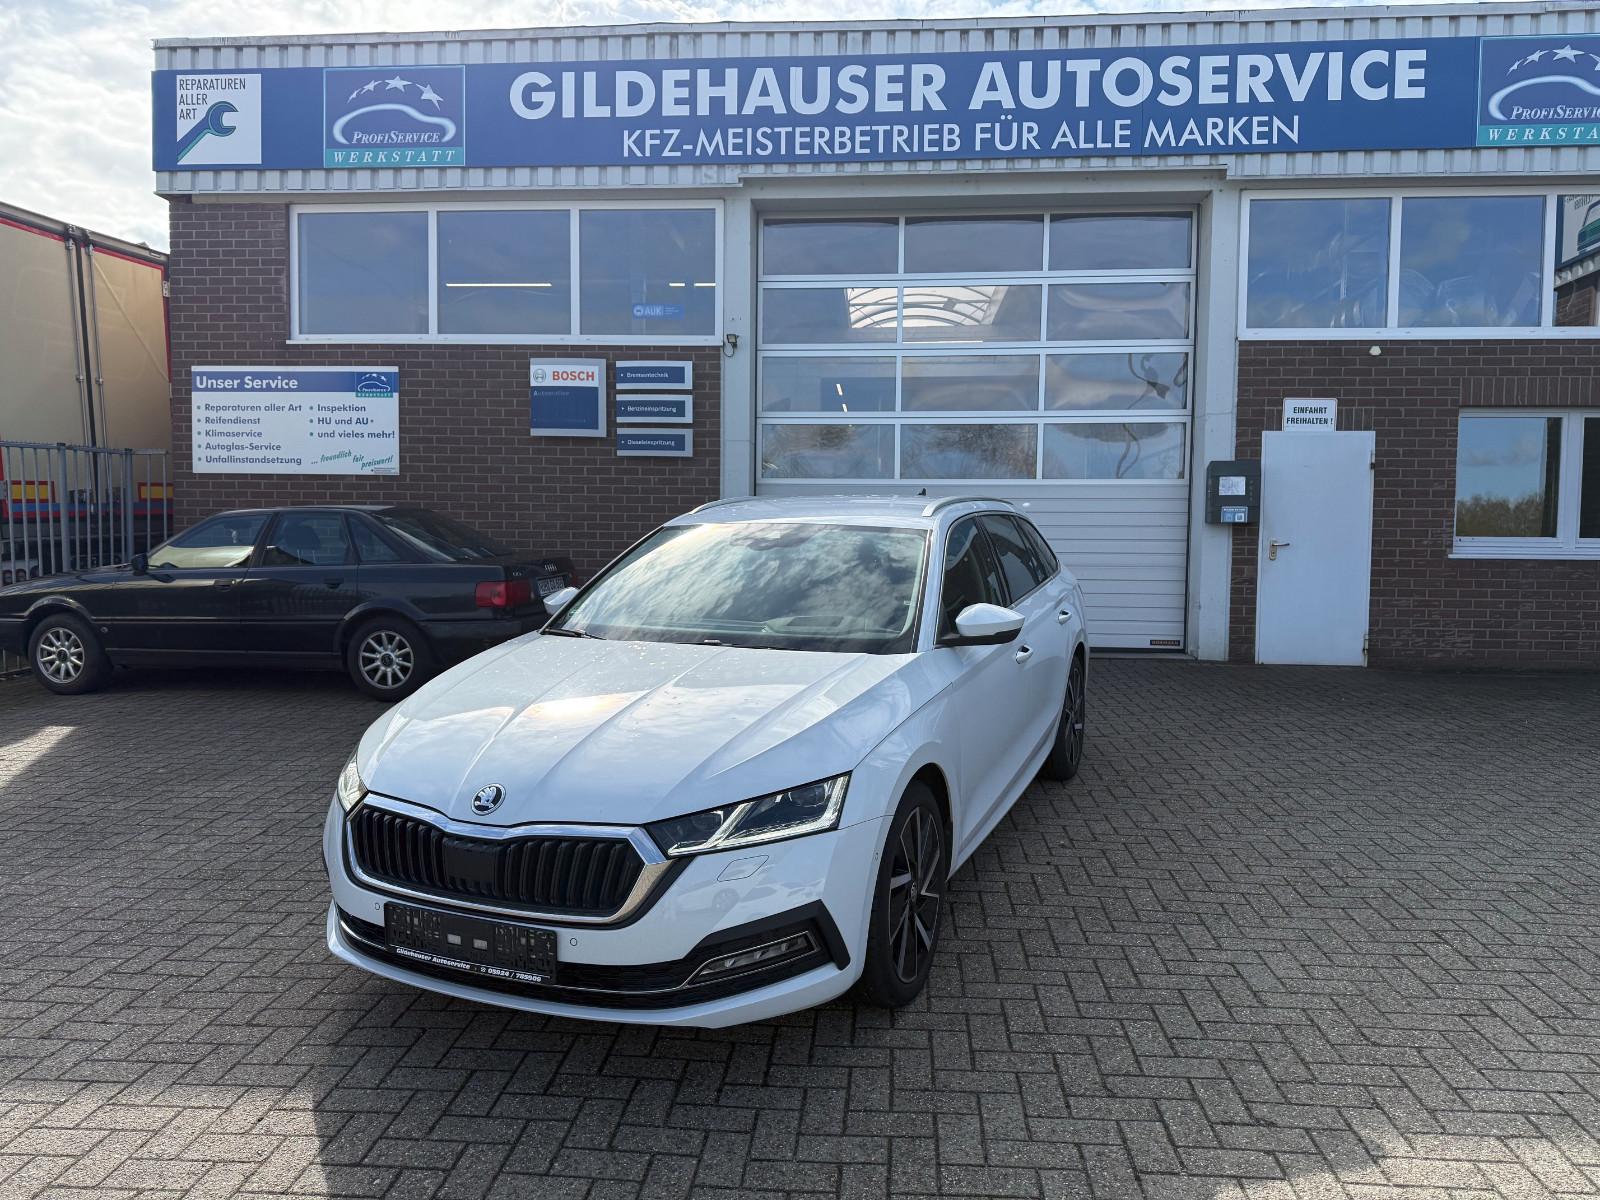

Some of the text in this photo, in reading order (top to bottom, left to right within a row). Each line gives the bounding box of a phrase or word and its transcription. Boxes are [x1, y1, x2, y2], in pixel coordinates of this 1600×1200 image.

[178, 77, 246, 91] REPARATUREN
[509, 49, 1427, 120] GILDEHAUSER AUTOSERVICE
[178, 93, 208, 106] ALLER
[178, 107, 198, 120] ART
[623, 114, 1299, 157] KFZ-MEISTERBETRIEB FÜR ALLE MARKEN
[333, 150, 456, 163] WERKSTATT
[552, 371, 595, 381] BOSCH
[196, 376, 298, 389] Unser Service
[204, 403, 302, 413] Reparaturen aller Art
[317, 404, 366, 413] Inspektion
[1293, 406, 1328, 414] EINFAHRT
[204, 416, 261, 425] Reifendienst
[317, 417, 369, 425] HU und AU
[1286, 417, 1329, 425] FREIHALTEN
[204, 429, 263, 438] Klimaservice
[317, 430, 396, 439] und vieles mehr!
[205, 442, 282, 451] Autoglas-Service
[205, 455, 302, 465] Unfallinstandsetzung
[320, 449, 352, 463] freundlich
[432, 957, 471, 970] Autoservice
